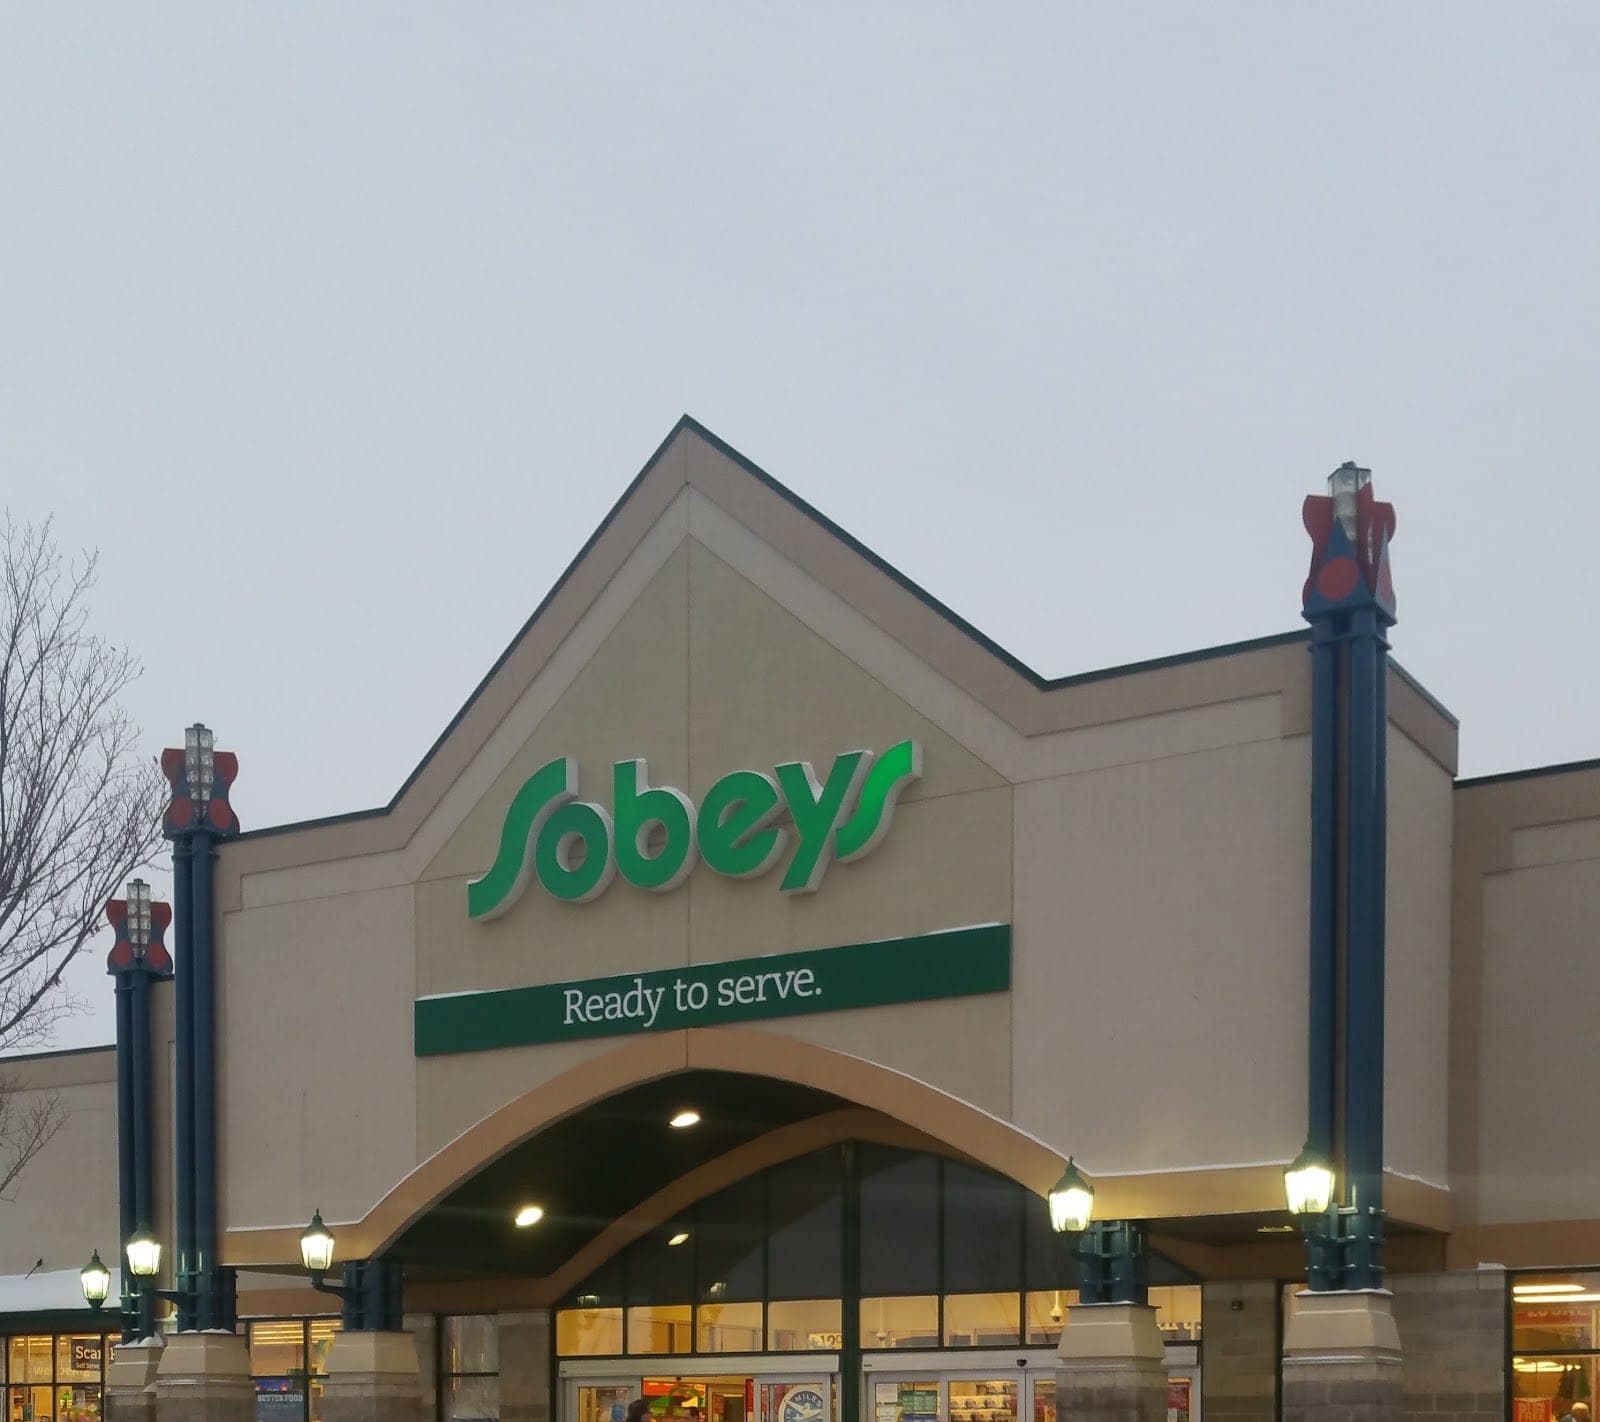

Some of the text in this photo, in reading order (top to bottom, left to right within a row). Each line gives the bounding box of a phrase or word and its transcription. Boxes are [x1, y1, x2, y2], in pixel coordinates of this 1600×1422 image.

[467, 739, 923, 922] Sobeys
[563, 966, 823, 1027] Ready to serve.
[794, 1393, 822, 1409] MILES
